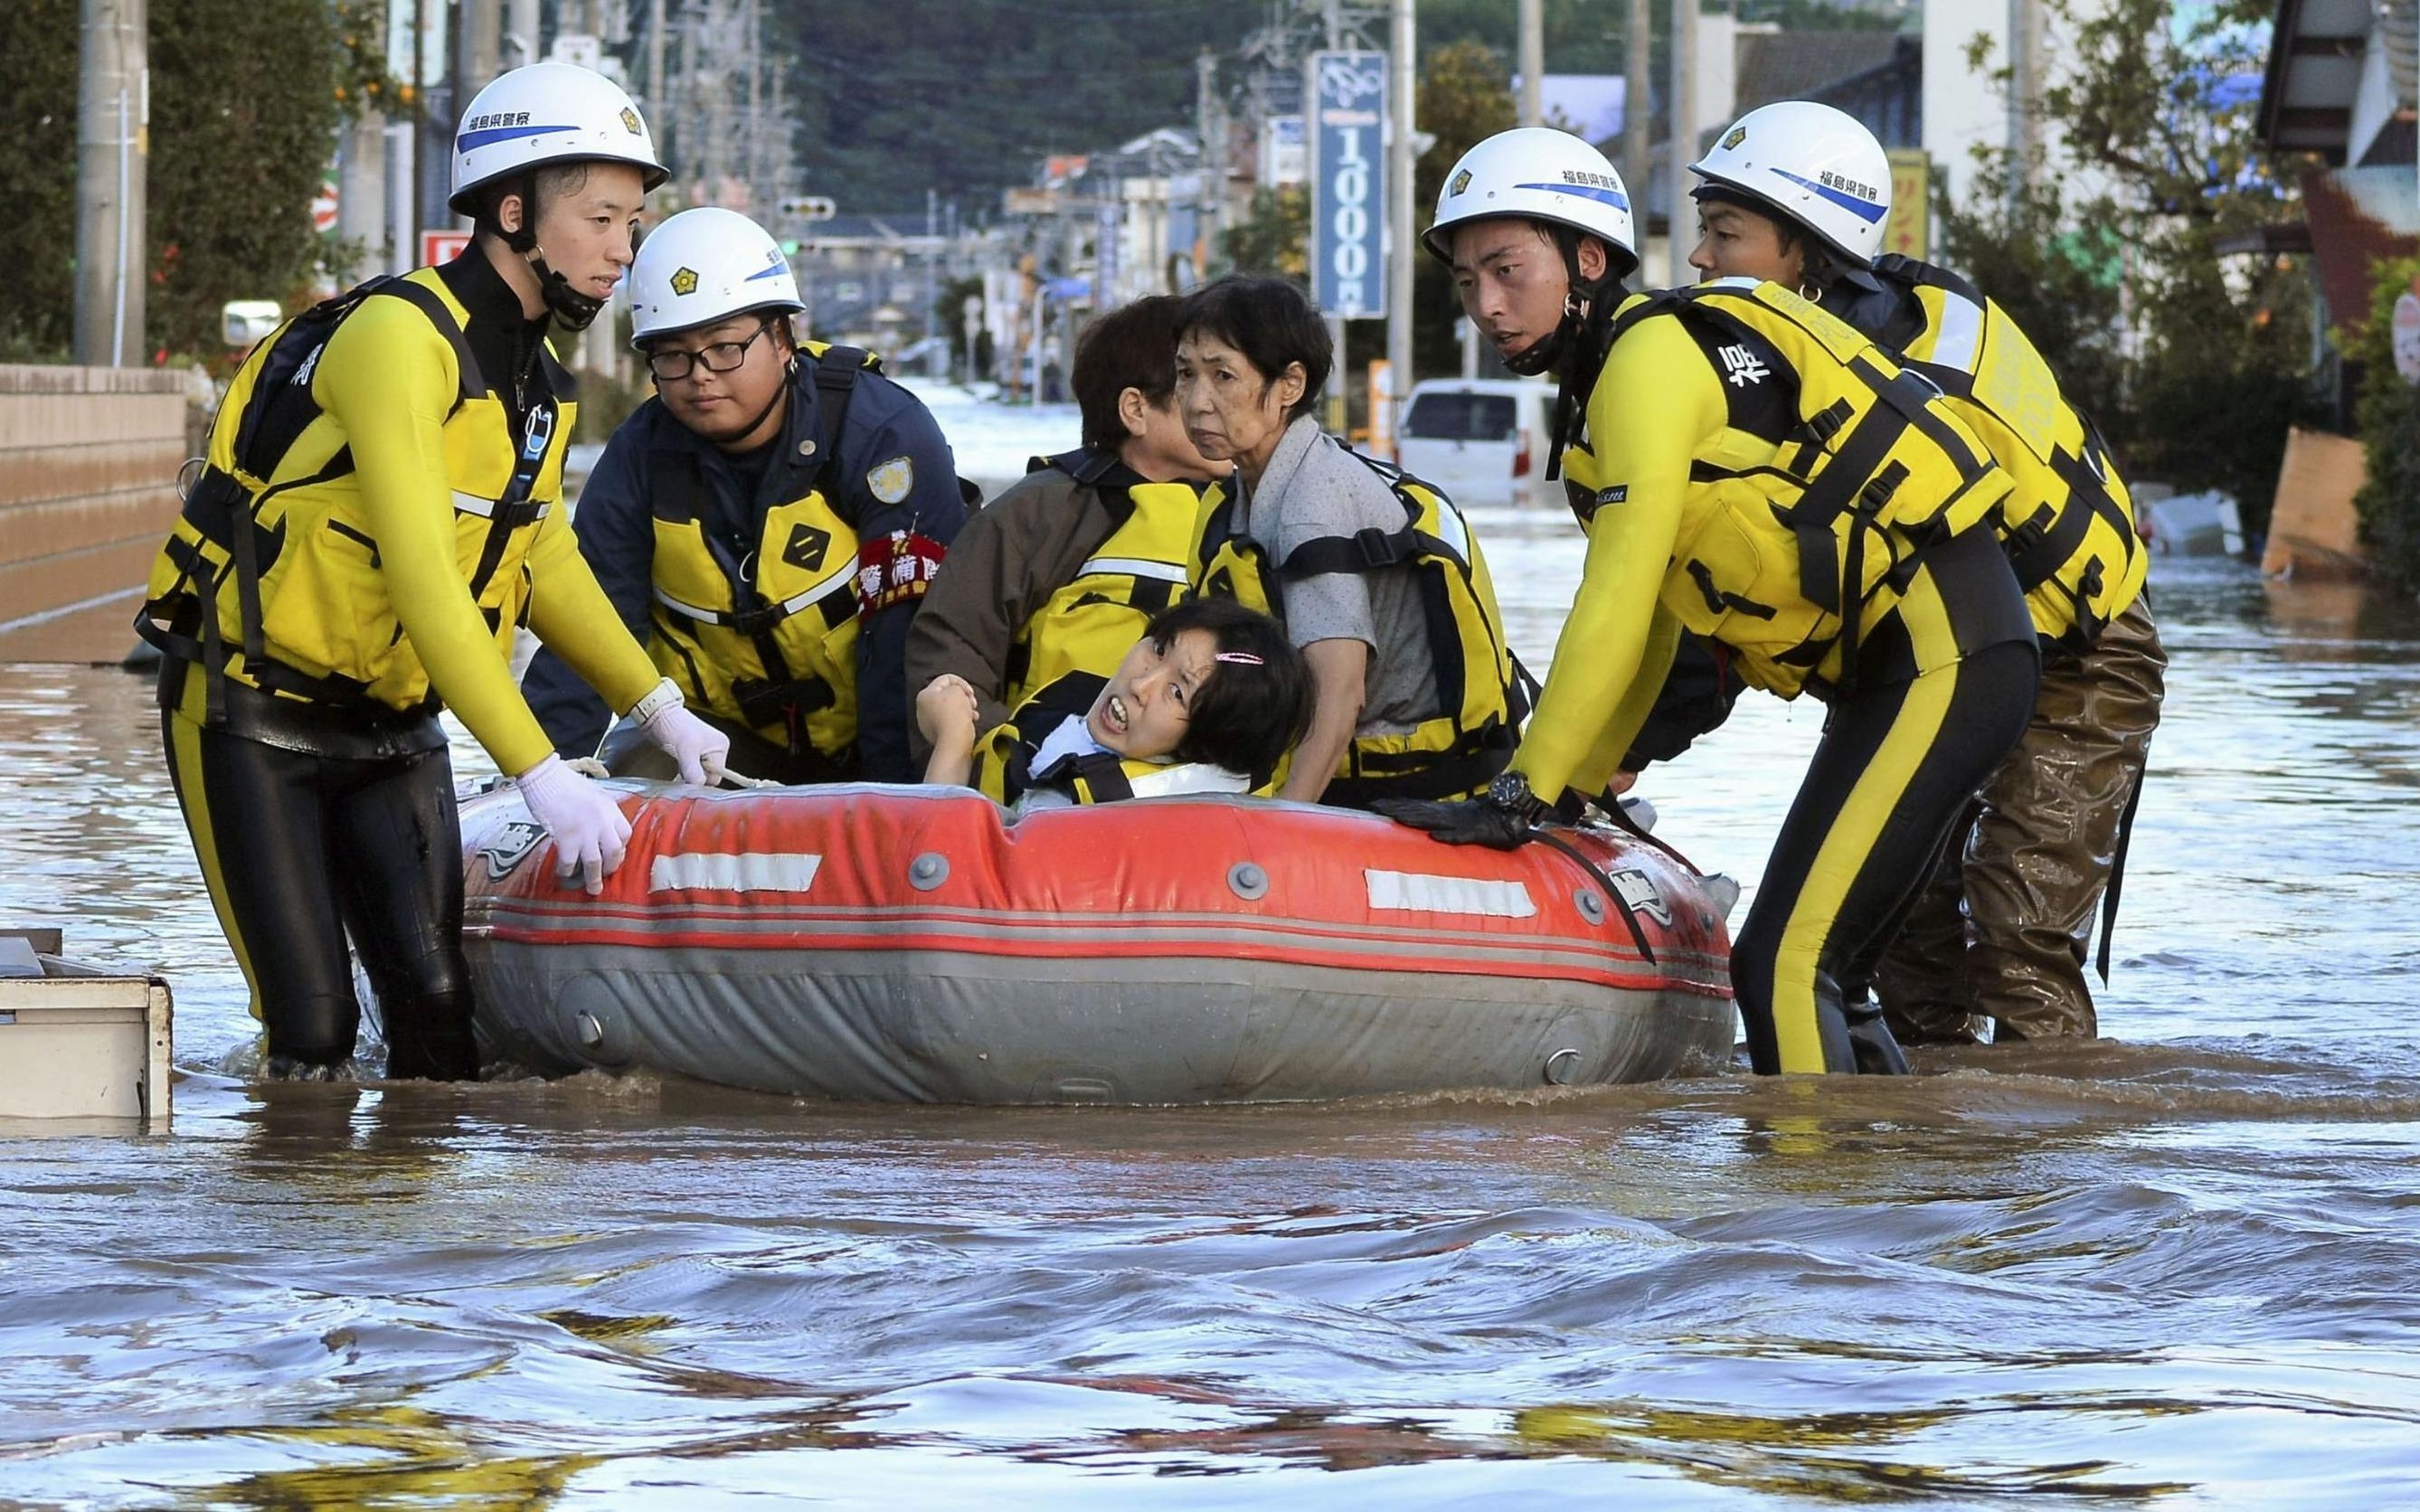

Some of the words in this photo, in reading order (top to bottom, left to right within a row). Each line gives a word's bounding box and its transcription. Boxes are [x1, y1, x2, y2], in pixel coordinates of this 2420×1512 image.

[468, 111, 530, 130] 福島県警察
[1820, 170, 1877, 202] 福島県警察
